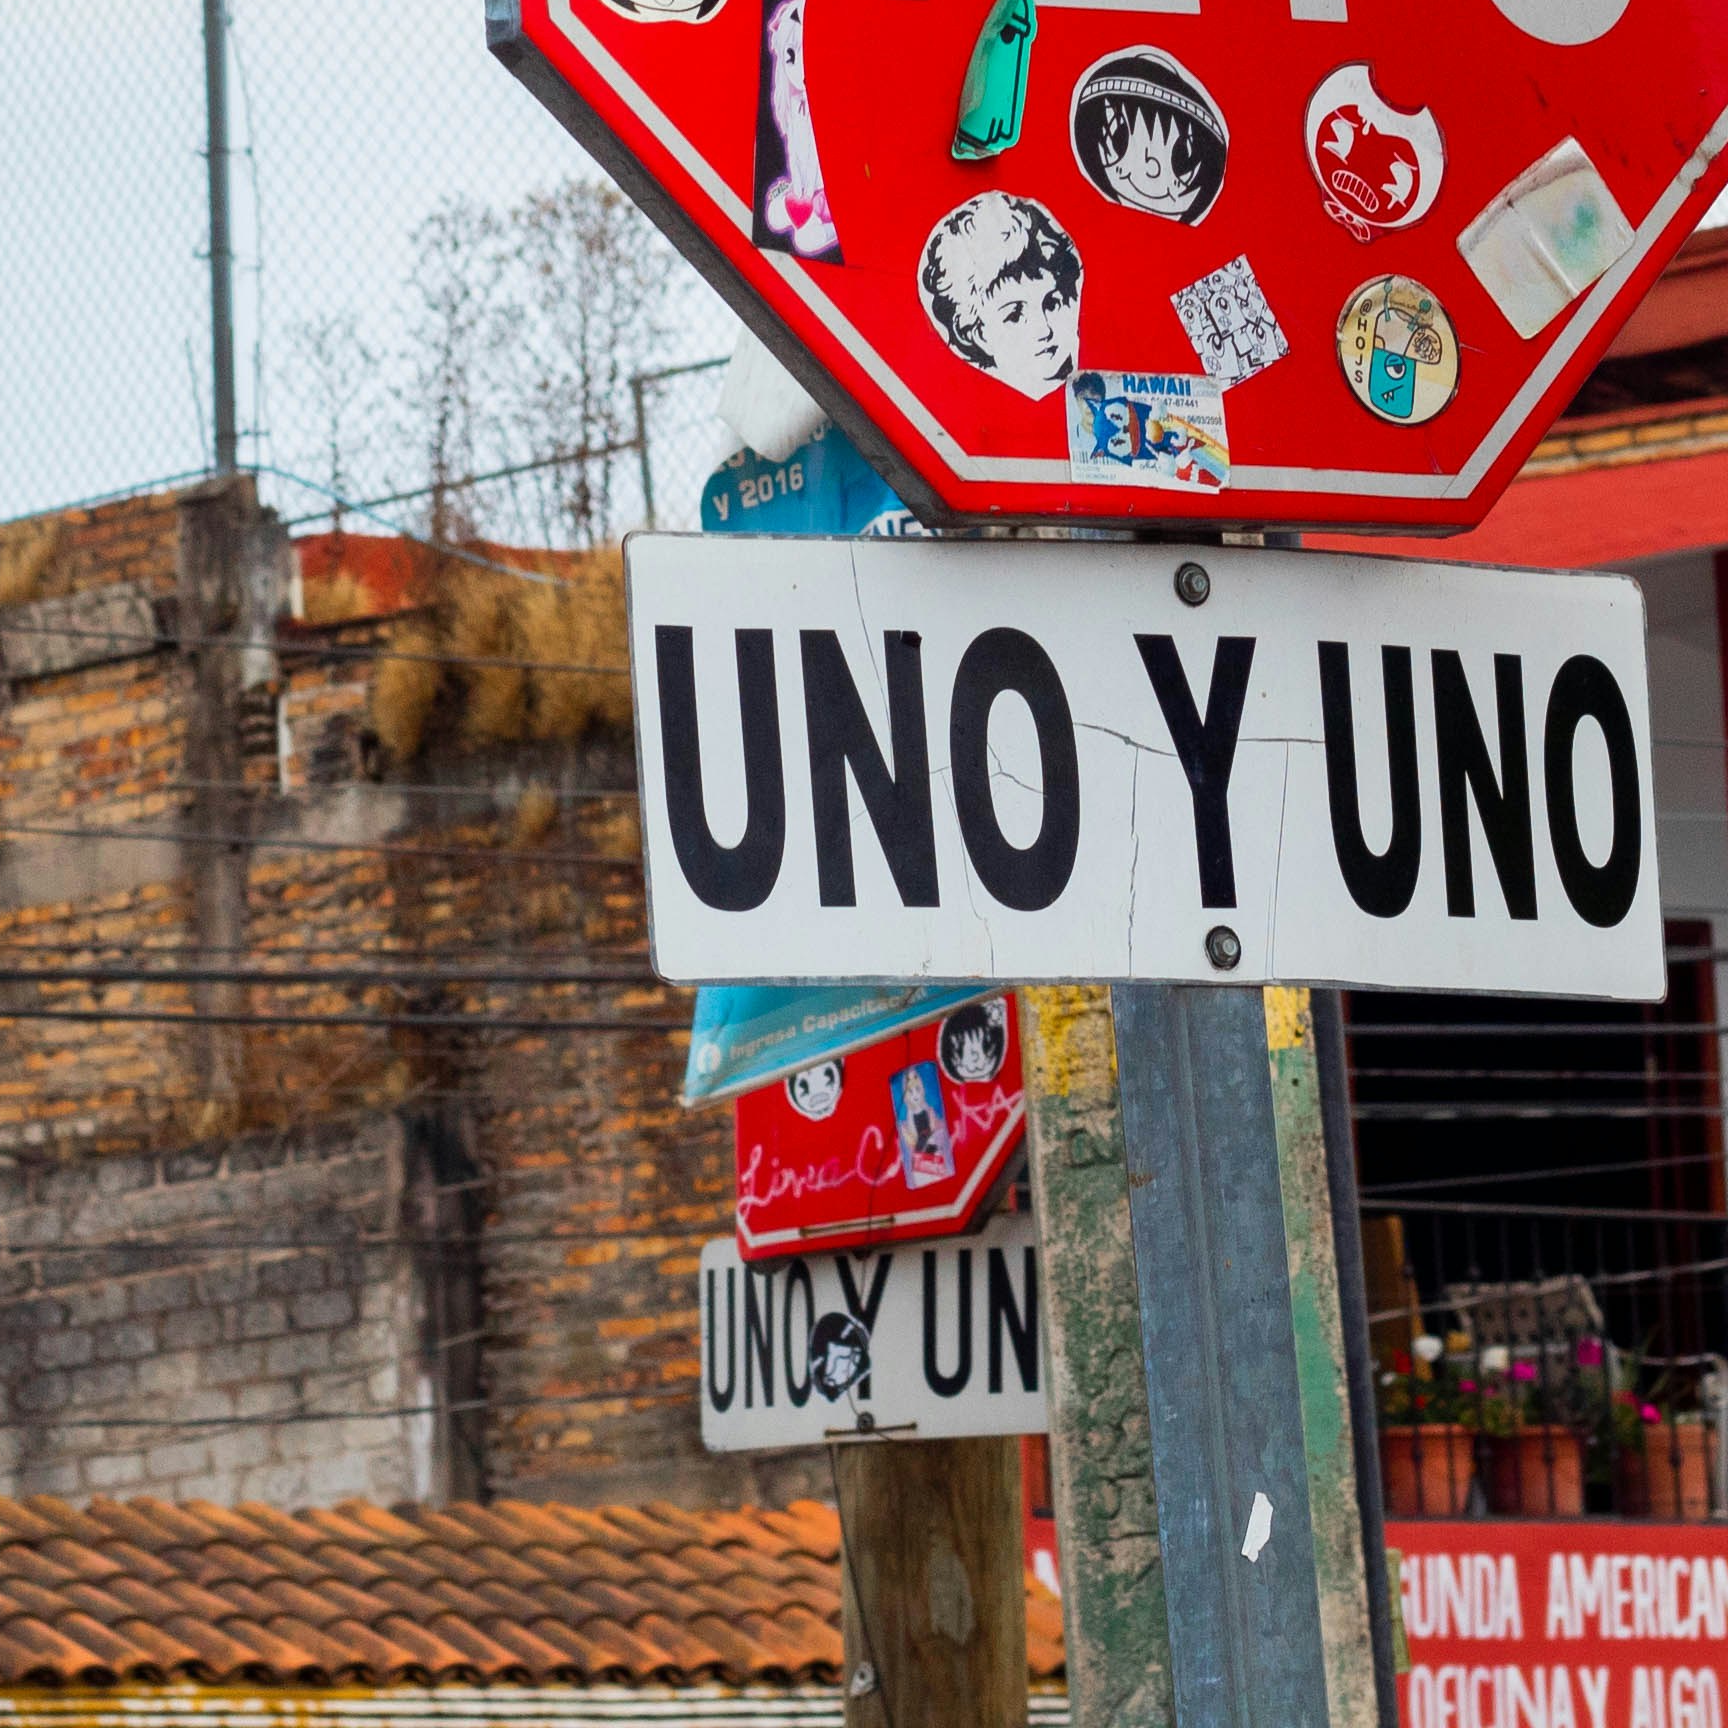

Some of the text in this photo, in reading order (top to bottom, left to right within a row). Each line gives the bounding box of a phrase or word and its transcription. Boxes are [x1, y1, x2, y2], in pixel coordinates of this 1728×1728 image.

[713, 463, 804, 521] y 2016
[655, 624, 1643, 929] UNO Y UNO
[707, 1259, 816, 1413] UNO
[1409, 1666, 1575, 1728] OFICINA
[1576, 1666, 1610, 1728] Y
[1630, 1665, 1722, 1728] ALGO
